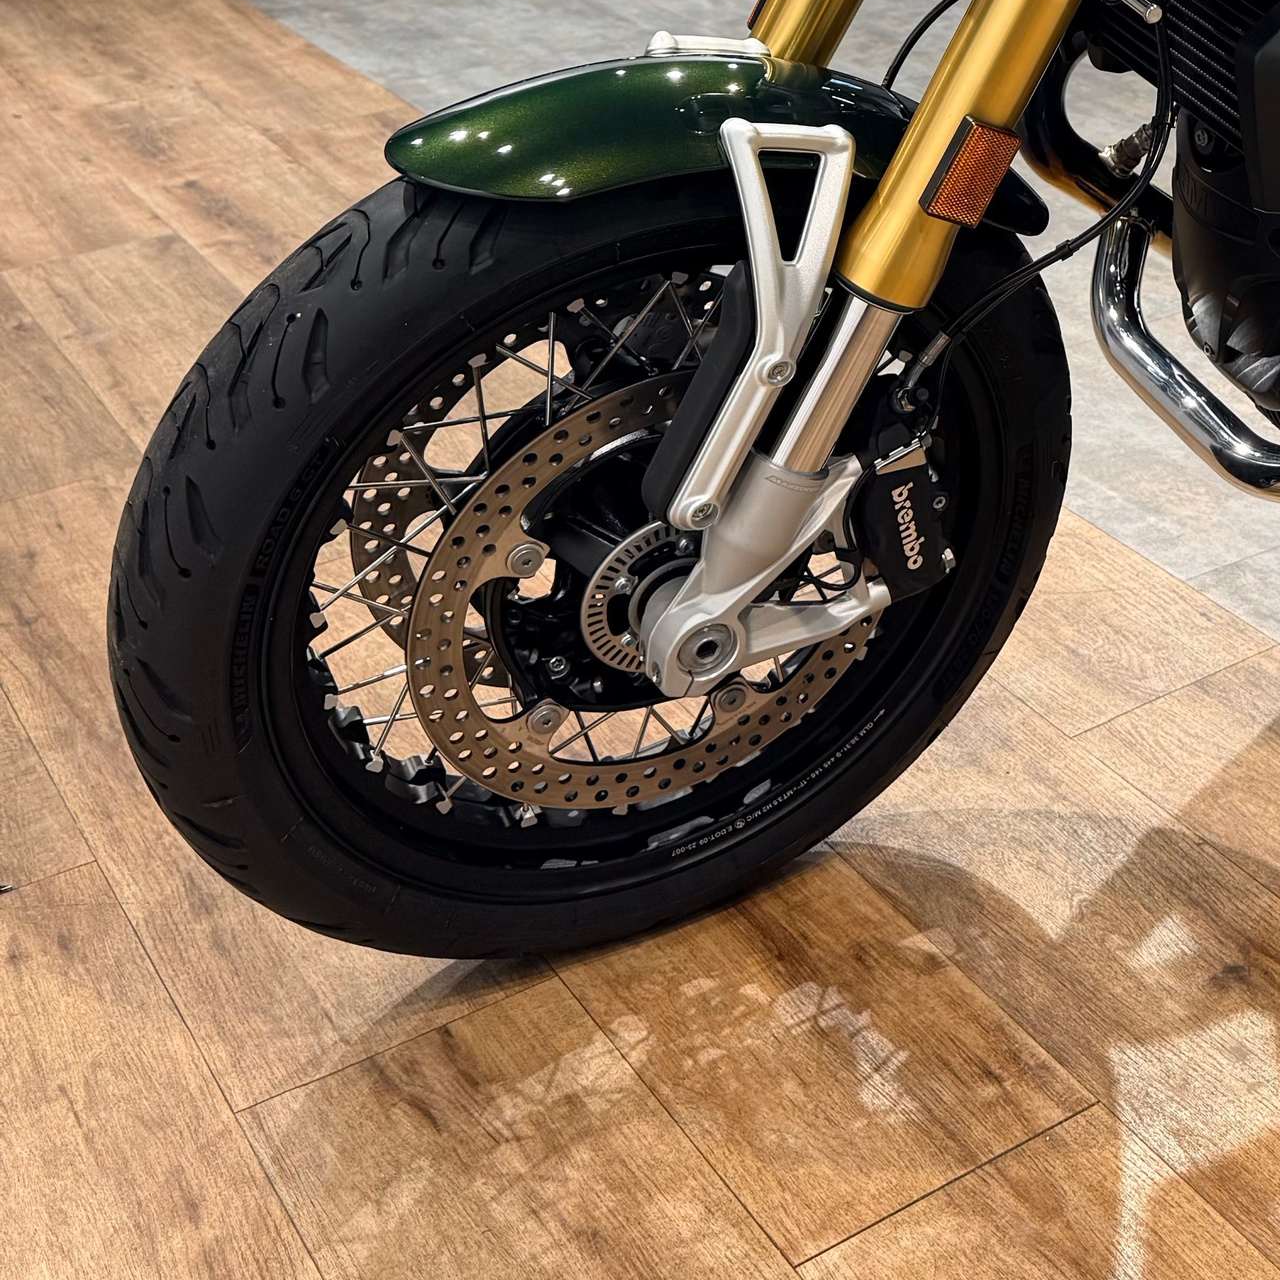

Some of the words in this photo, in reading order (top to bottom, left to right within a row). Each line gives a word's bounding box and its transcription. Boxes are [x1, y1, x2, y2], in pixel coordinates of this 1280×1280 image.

[255, 506, 291, 571] ROAD
[289, 487, 303, 503] 6
[301, 449, 324, 484] GT
[891, 482, 926, 570] brembo
[231, 593, 257, 709] MICHELIN
